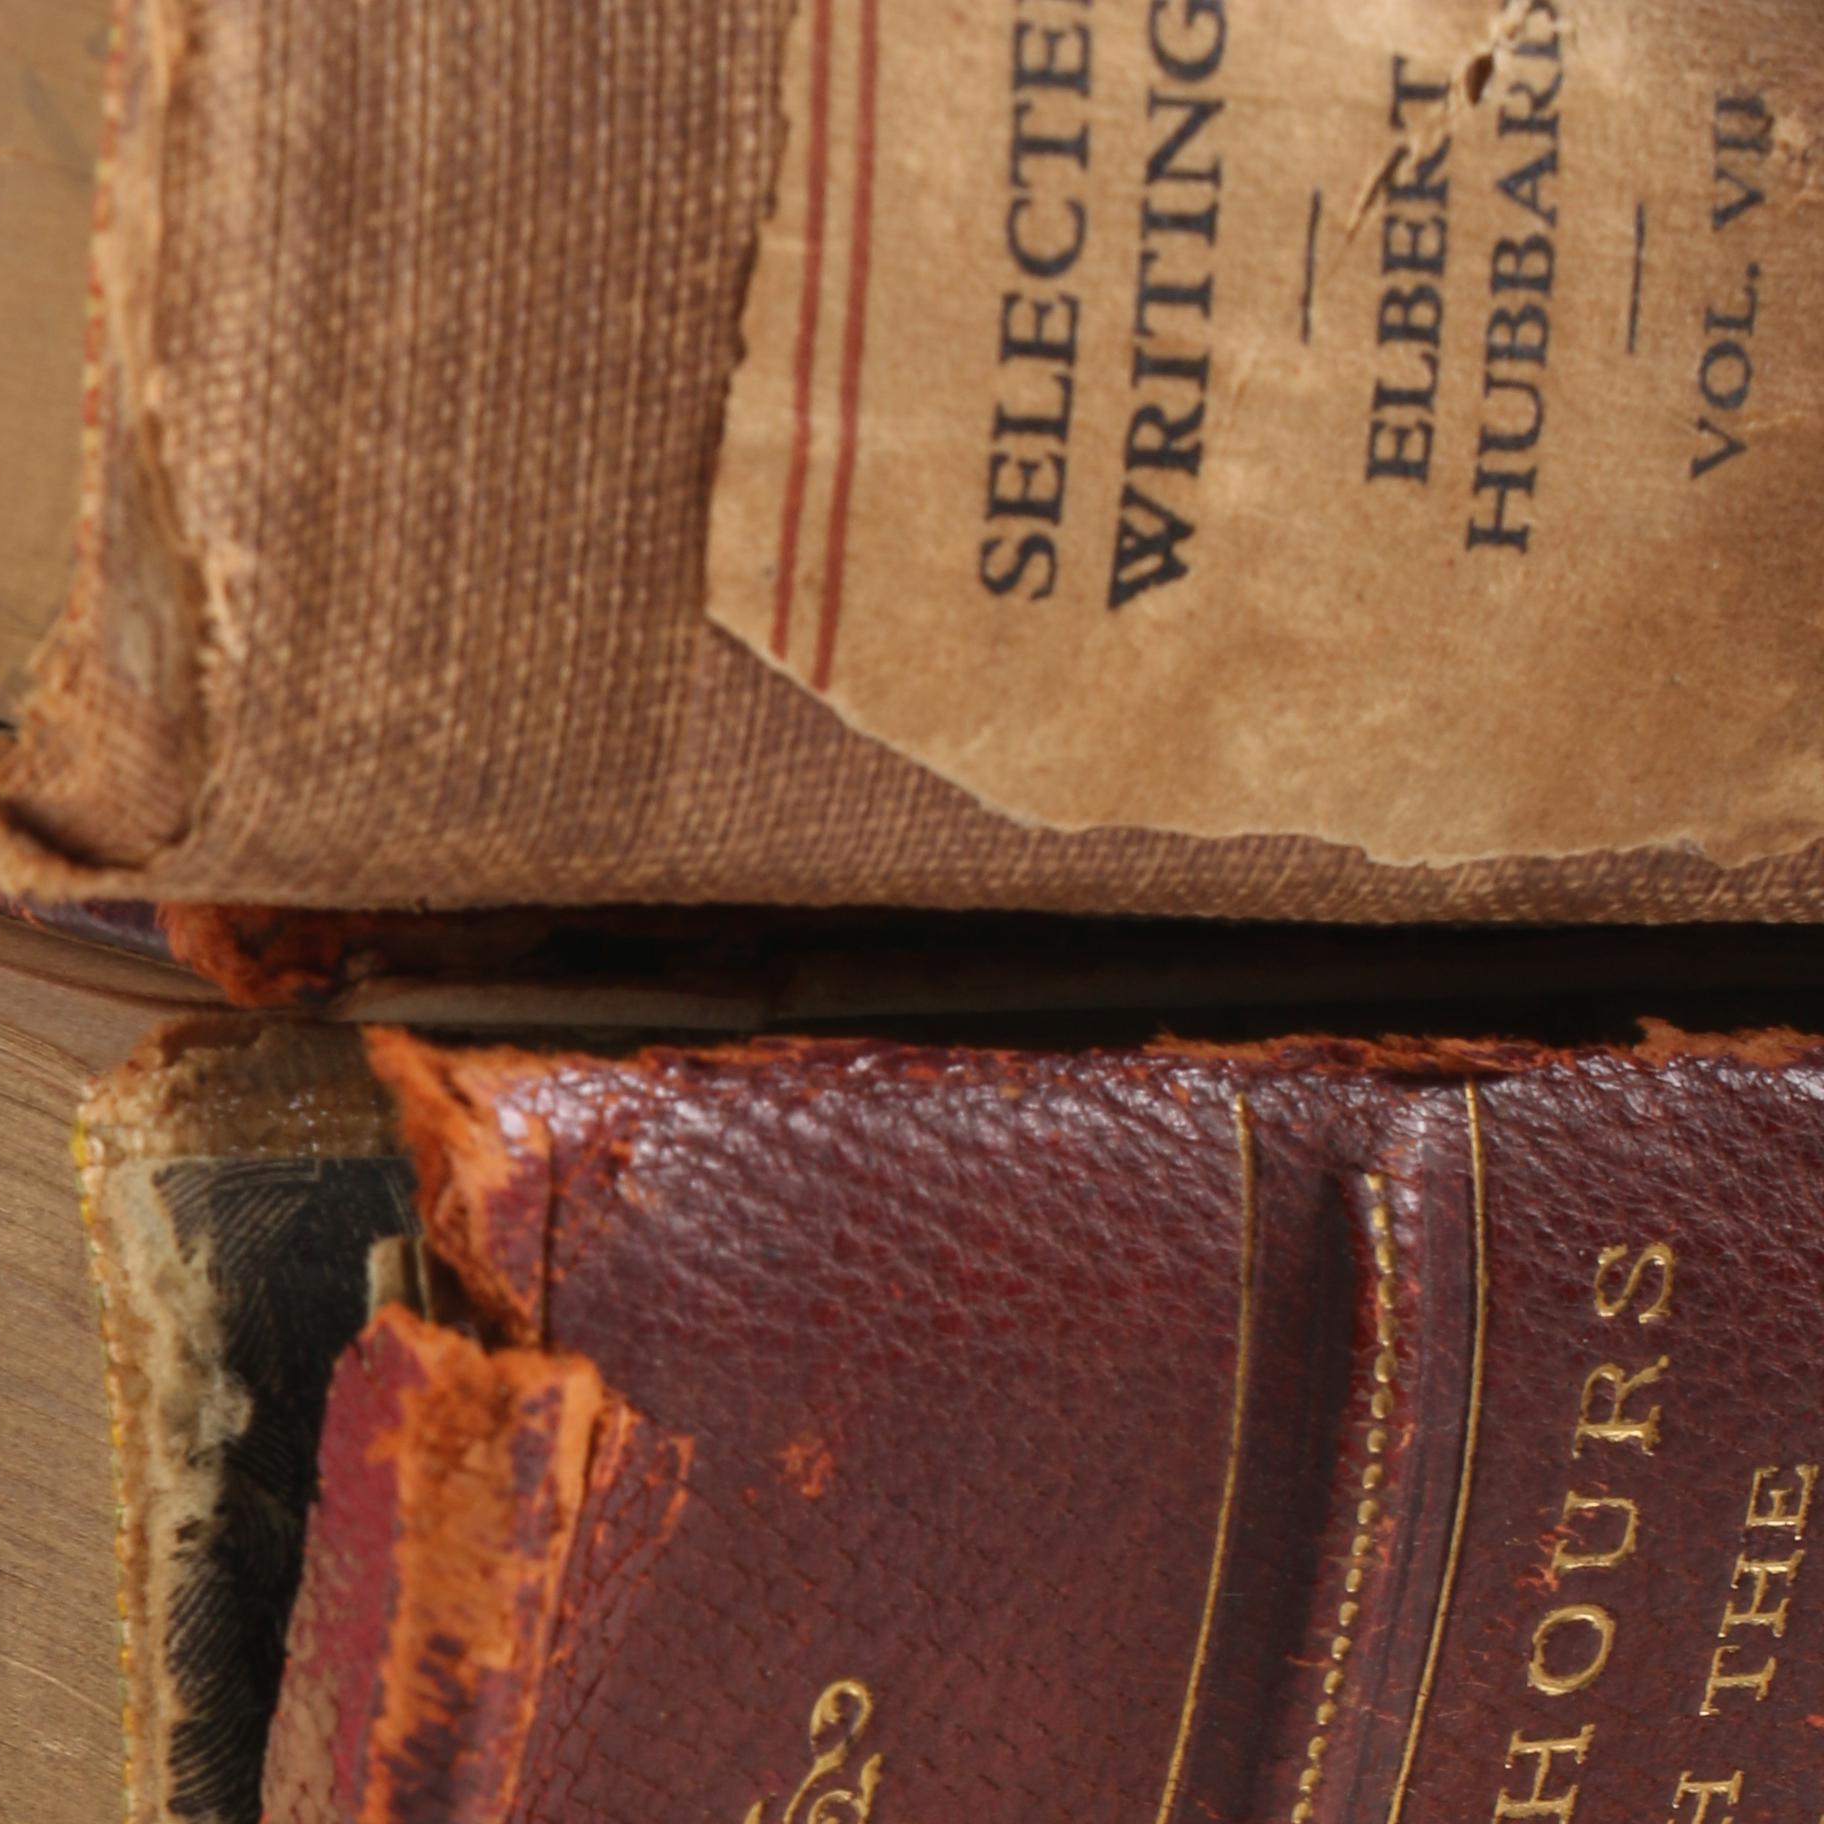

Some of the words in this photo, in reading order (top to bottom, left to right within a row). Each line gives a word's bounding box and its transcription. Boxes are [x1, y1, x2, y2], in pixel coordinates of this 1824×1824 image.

[980, 0, 1093, 600] SELECTE
[1364, 56, 1453, 485] ELBERT
[1690, 262, 1760, 478] VOL.
[1700, 1463, 1819, 1716] THE
